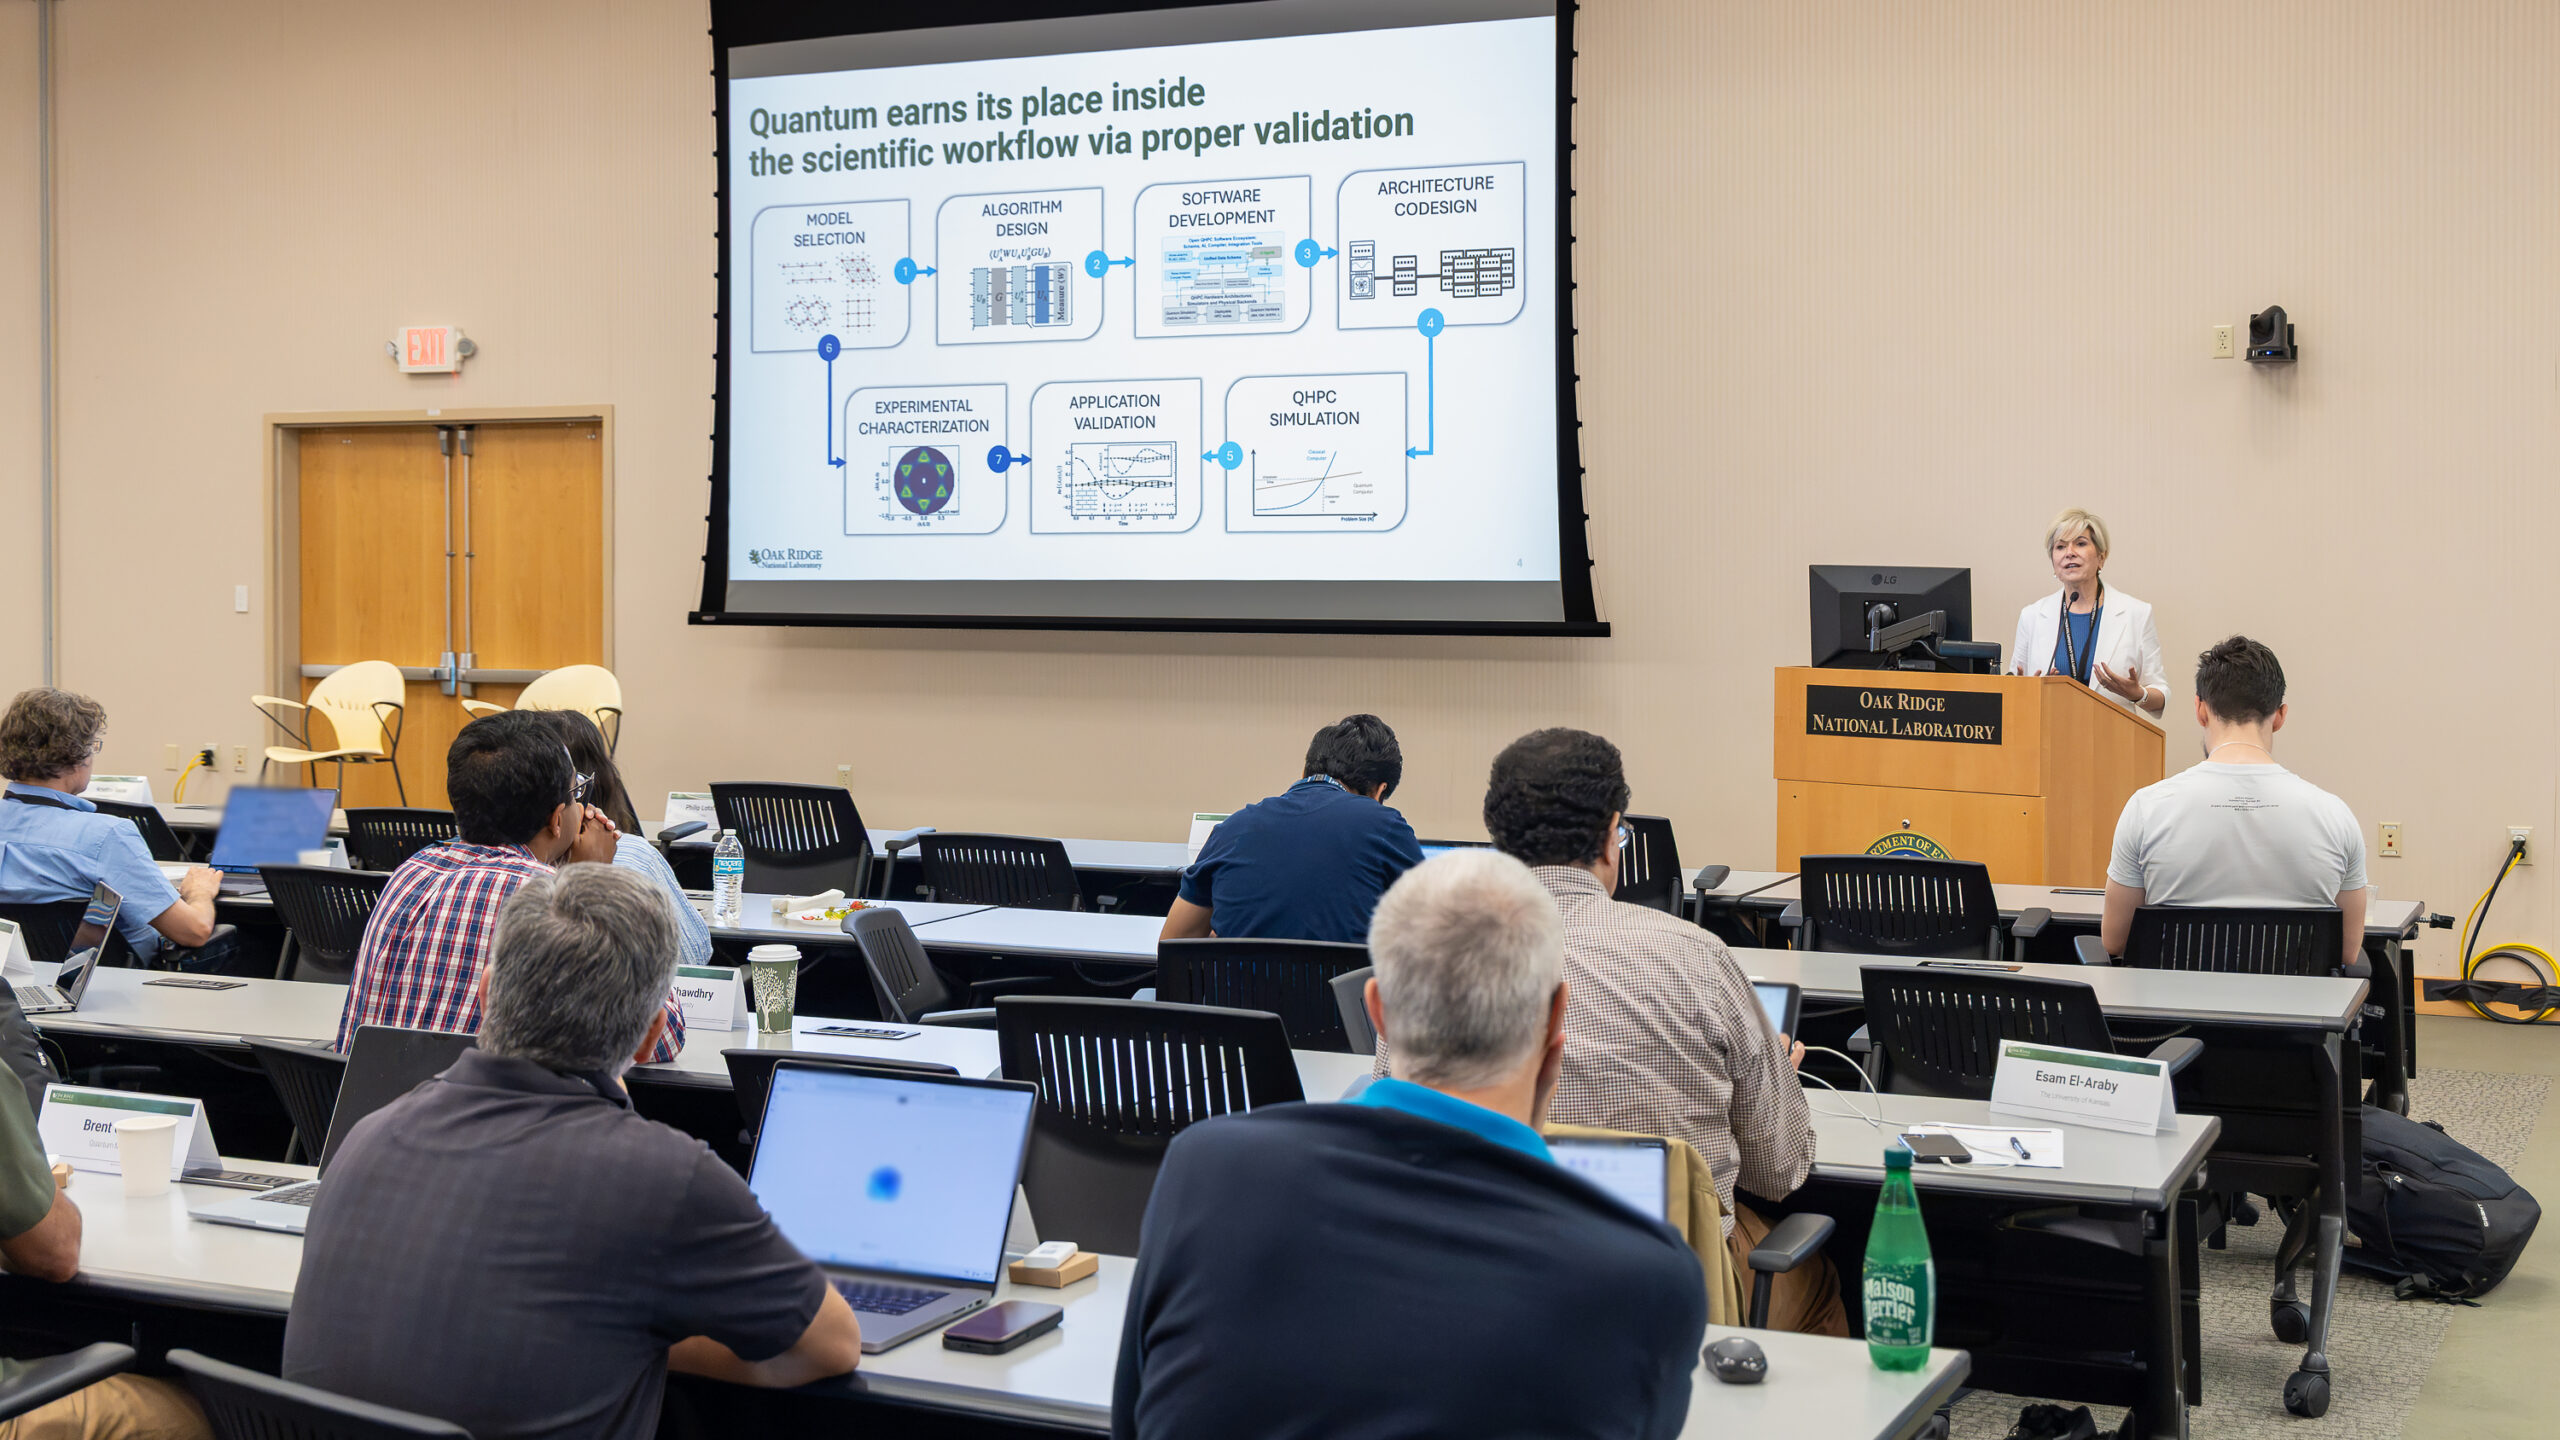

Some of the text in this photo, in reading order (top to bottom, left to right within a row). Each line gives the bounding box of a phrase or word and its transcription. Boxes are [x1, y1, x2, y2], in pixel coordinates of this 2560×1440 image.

[750, 76, 1205, 139] Quantum earns its place inside
[749, 108, 1413, 176] the scientific workflow via proper validation
[1378, 176, 1494, 195] ARCHITECTURE
[1183, 189, 1260, 205] SOFTWARE
[982, 200, 1061, 216] ALGORITHM
[1395, 199, 1476, 216] CODESIGN
[807, 212, 852, 225] MODEL
[1170, 210, 1275, 227] DEVELOPMENT
[997, 222, 1047, 236] DESIGN
[794, 232, 864, 247] SELECTION
[1303, 247, 1311, 260] 3
[903, 265, 909, 277] 1
[1093, 258, 1100, 270] 2
[995, 292, 1004, 302] G
[1057, 285, 1065, 320] Measure
[1426, 317, 1434, 329] 4
[407, 328, 448, 366] EXIT
[825, 343, 833, 353] 6
[1070, 394, 1160, 409] APPLICATION
[1293, 390, 1336, 406] QHPC
[876, 400, 972, 414] EXPERIMENTAL
[1074, 416, 1155, 430] VALIDATION
[1270, 412, 1359, 426] SIMULATION
[859, 420, 988, 434] CHARACTERIZATION
[995, 454, 1002, 465] 7
[1226, 450, 1234, 462] 5
[789, 561, 822, 570] Laboratory
[1516, 558, 1524, 568] 4
[1883, 576, 1897, 585] LG
[1869, 836, 1915, 856] RTMENT
[1916, 838, 1932, 852] OF
[2036, 1070, 2119, 1094] Esam El-Araby
[2040, 1090, 2051, 1098] The
[83, 1119, 112, 1133] Brent
